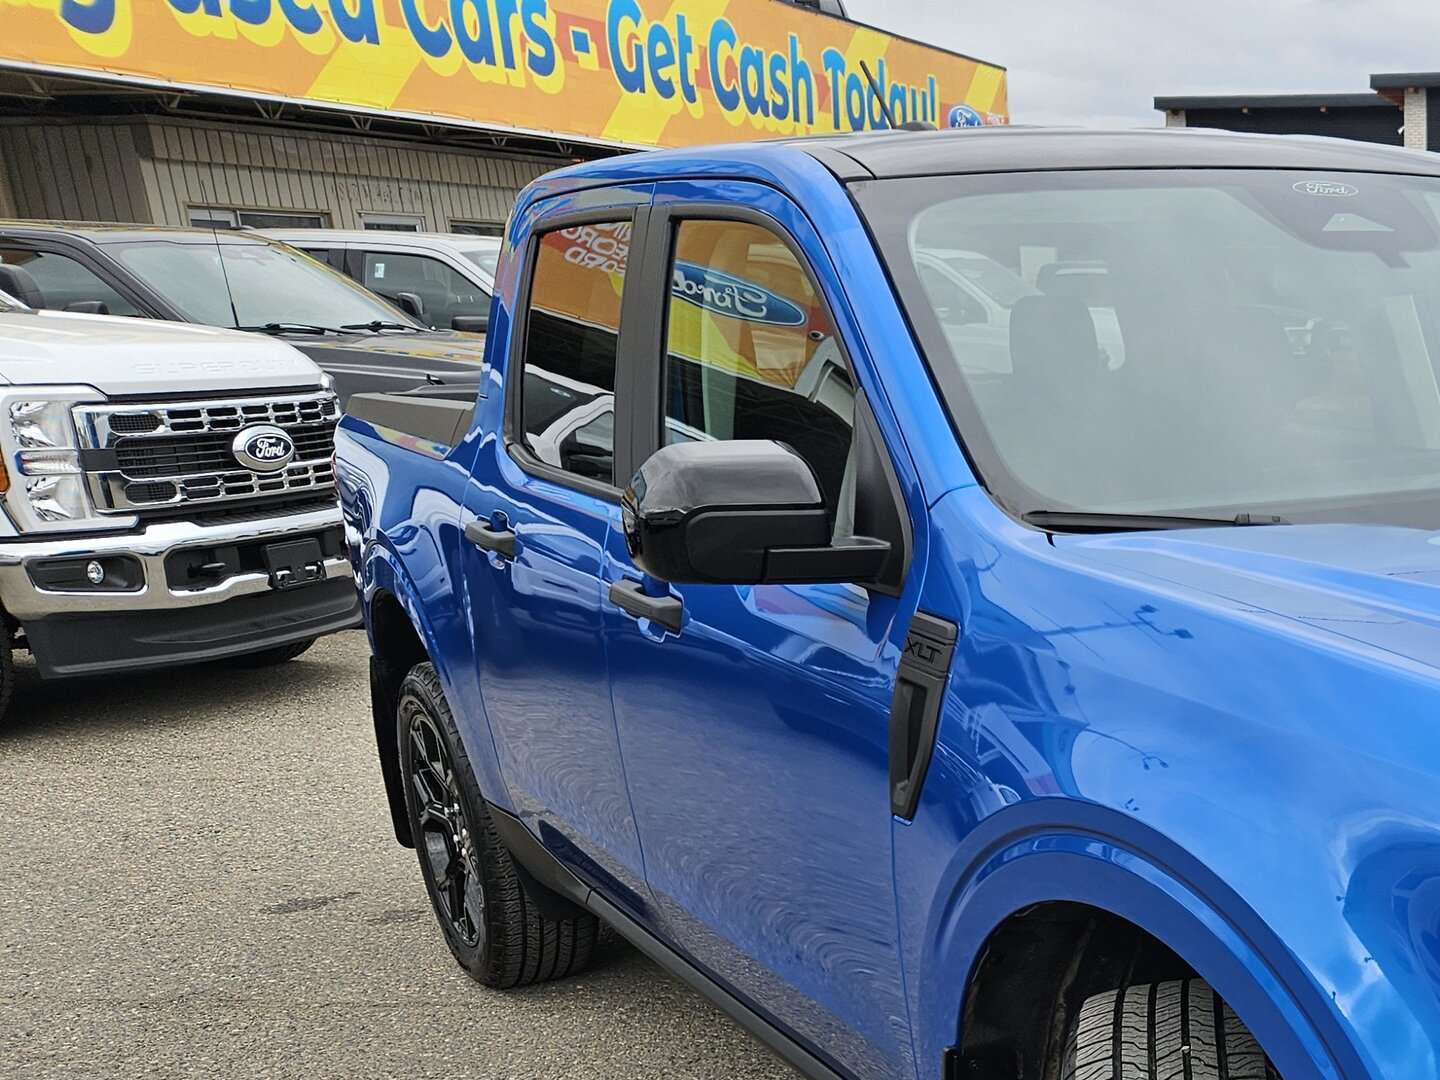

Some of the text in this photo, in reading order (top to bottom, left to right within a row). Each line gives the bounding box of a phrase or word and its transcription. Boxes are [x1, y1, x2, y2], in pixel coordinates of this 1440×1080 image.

[400, 0, 555, 77] Cars
[606, 0, 697, 104] Get
[708, 18, 814, 126] Cash
[255, 438, 285, 459] Ford
[904, 637, 943, 665] XLT
